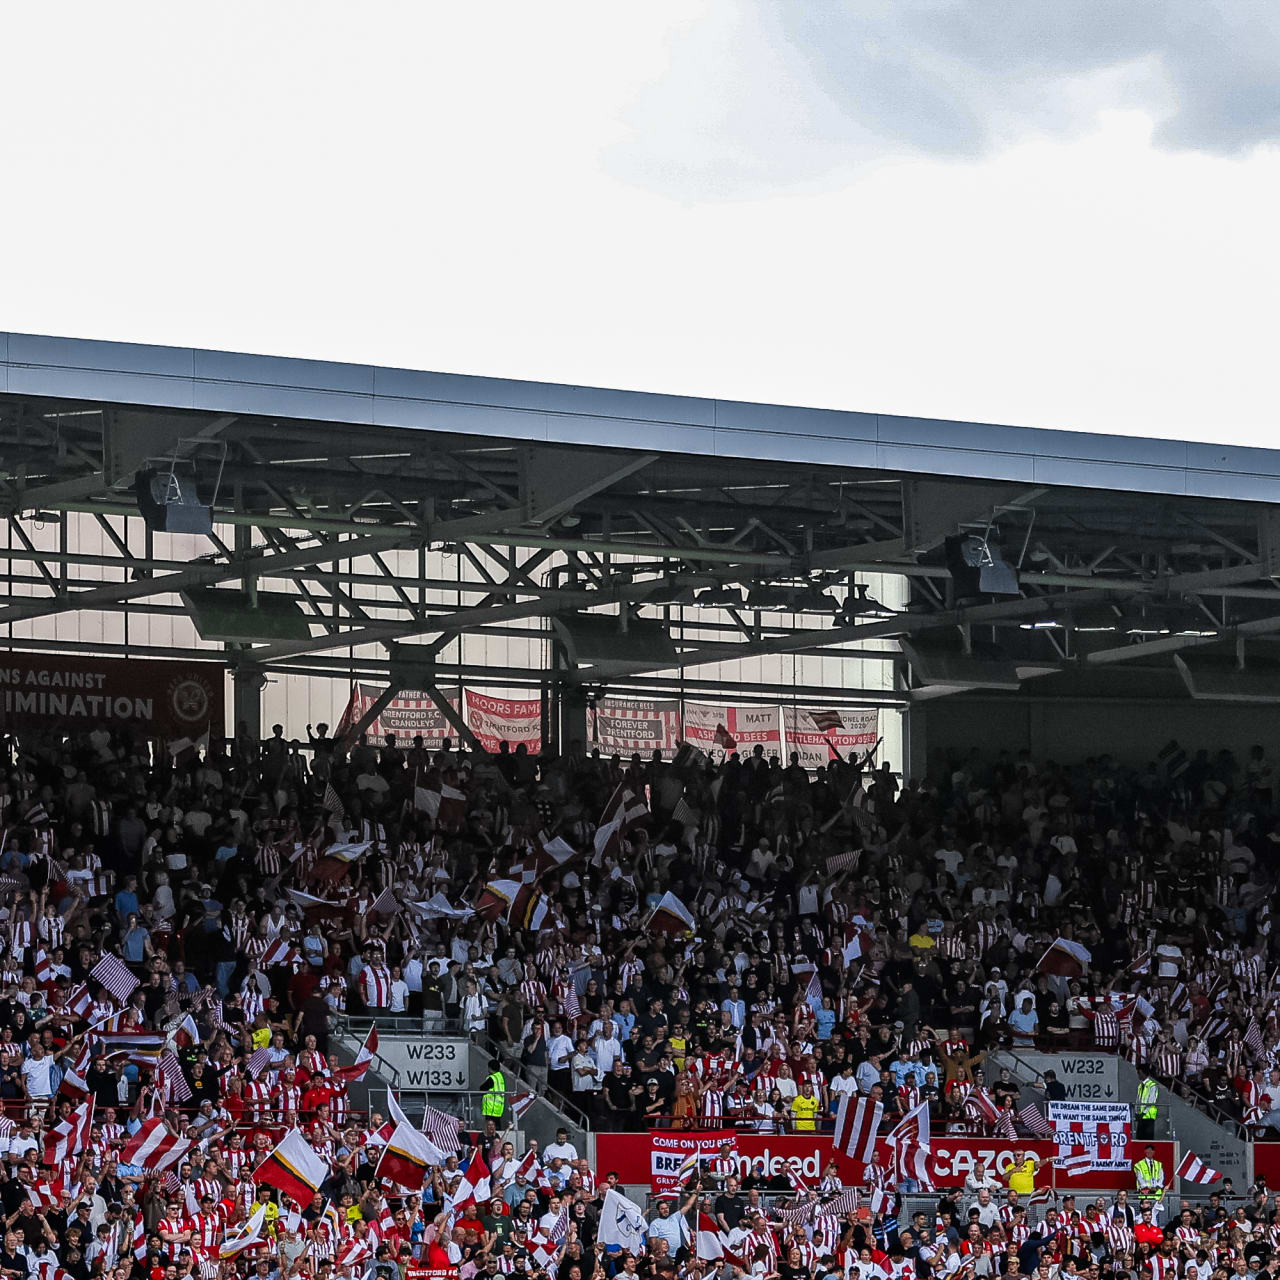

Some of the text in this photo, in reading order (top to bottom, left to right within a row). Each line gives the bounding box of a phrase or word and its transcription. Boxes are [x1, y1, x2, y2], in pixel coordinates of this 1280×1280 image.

[25, 670, 106, 689] AGAINST
[472, 696, 540, 715] MOORS FAMI
[383, 710, 426, 719] BRENTFORD
[745, 713, 771, 723] MATT
[610, 720, 649, 730] FOREVER
[606, 728, 655, 739] BRENTFORD
[697, 730, 768, 741] ASHRD BEES
[407, 1045, 456, 1060] W233
[1062, 1060, 1104, 1074] W232
[407, 1070, 452, 1086] W133
[1064, 1085, 1101, 1098] W132
[1060, 1103, 1080, 1111] DREAM
[652, 1136, 737, 1149] COME ON YOU BEES
[1053, 1131, 1128, 1147] BRENTFRD
[737, 1148, 820, 1178] ndeed
[449, 1269, 458, 1277] FC
